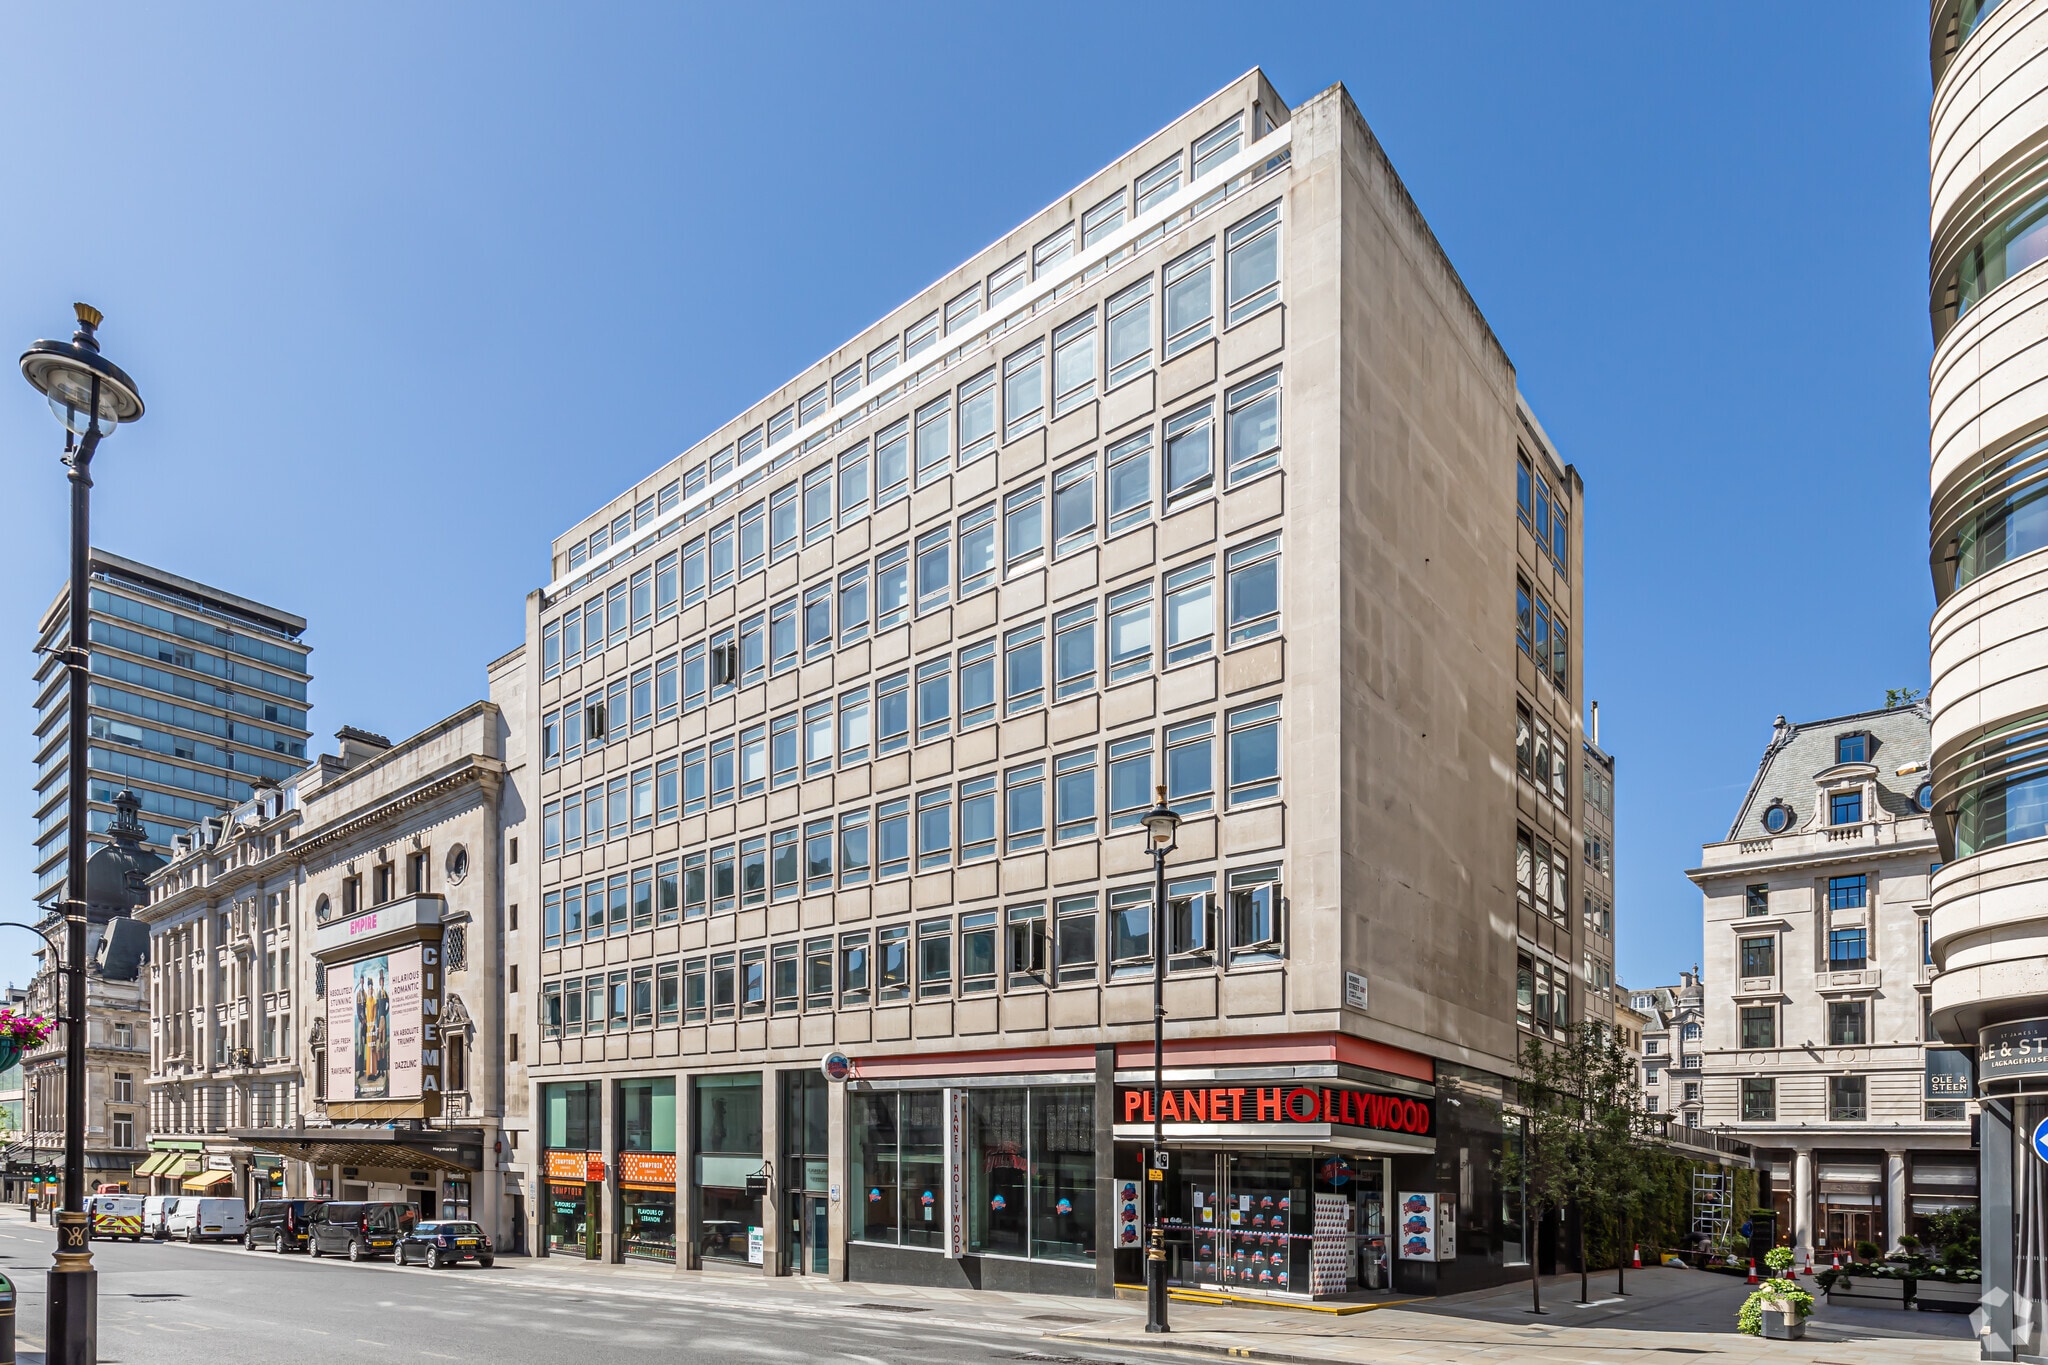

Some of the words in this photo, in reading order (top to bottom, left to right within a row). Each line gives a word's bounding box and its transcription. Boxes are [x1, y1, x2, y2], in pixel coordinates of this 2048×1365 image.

[350, 914, 377, 935] EMPIRE
[392, 971, 419, 984] HILARIOUS
[394, 982, 419, 994] ROMANTIC
[423, 947, 439, 1092] CINEMA
[2000, 1042, 2012, 1057] &
[1932, 1076, 1953, 1084] OLE
[1932, 1083, 1967, 1091] STEEN
[1125, 1088, 1247, 1122] PLANET
[1256, 1087, 1430, 1134] HOLLYWOOD
[551, 1186, 582, 1196] COMPTOIR
[637, 1208, 657, 1216] FLAVOURS
